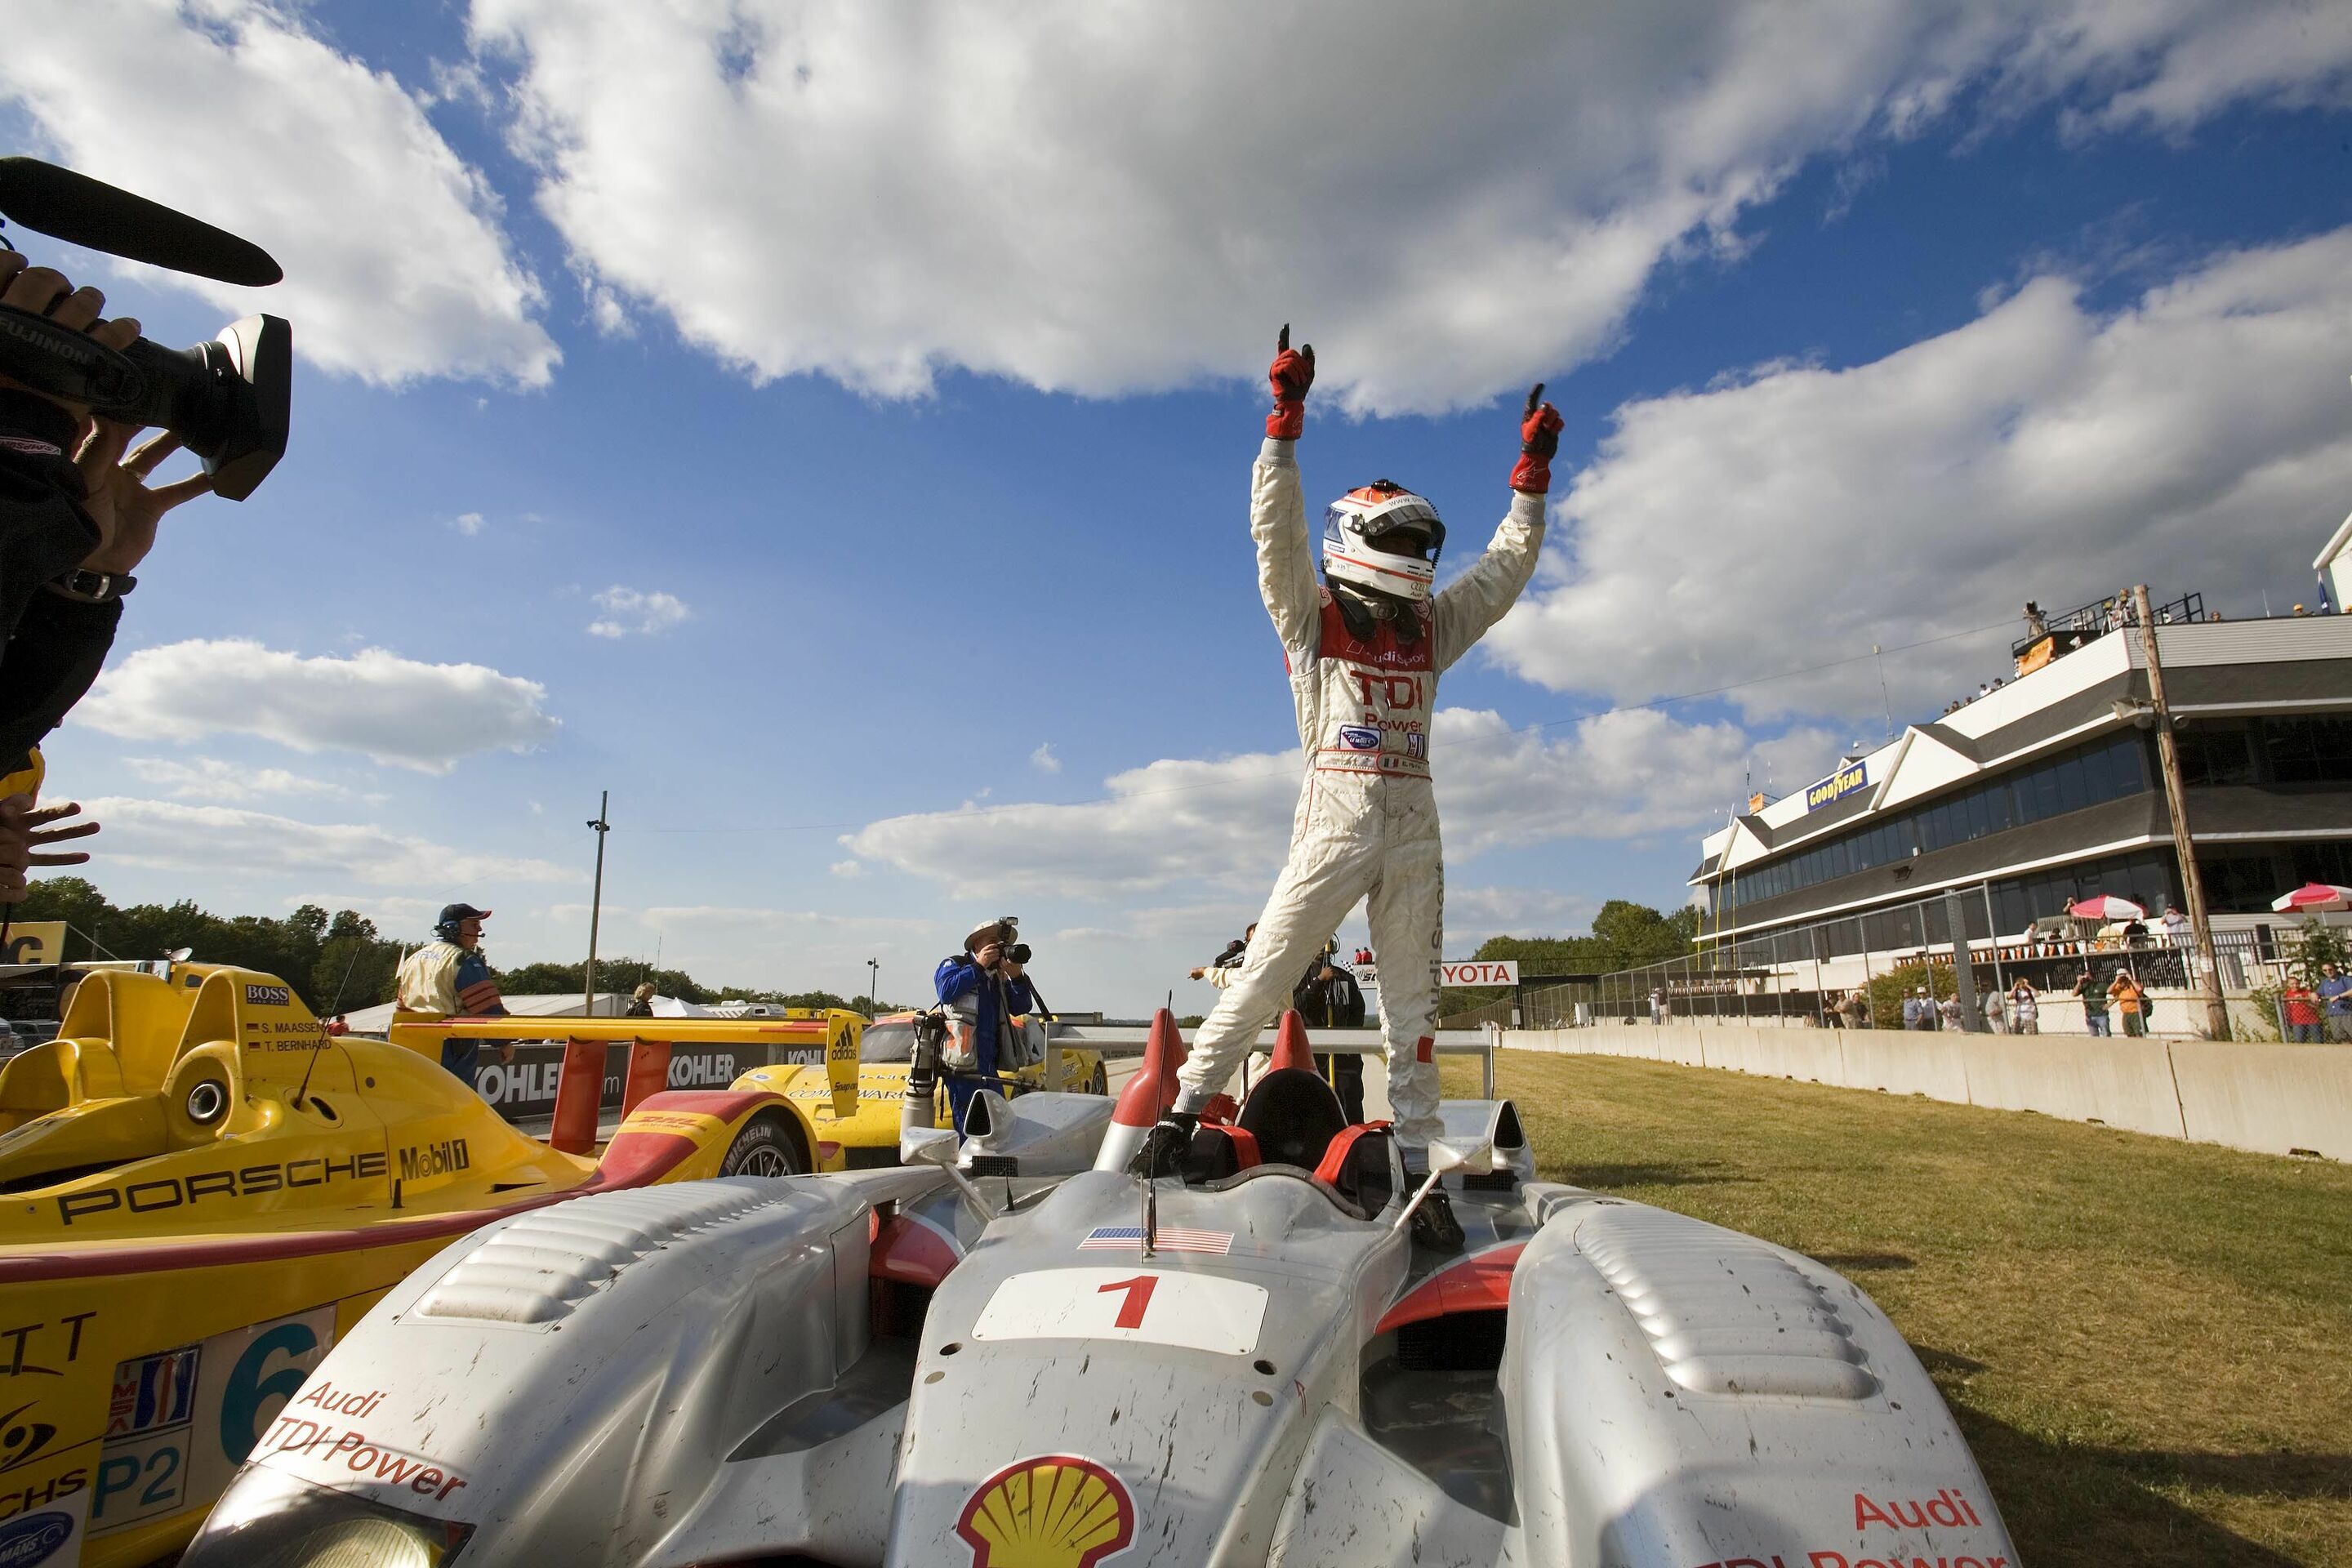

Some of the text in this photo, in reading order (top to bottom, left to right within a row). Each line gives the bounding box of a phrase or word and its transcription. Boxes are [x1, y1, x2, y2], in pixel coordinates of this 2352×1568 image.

[1350, 670, 1422, 711] TDI
[1365, 712, 1423, 733] Power
[1810, 768, 1863, 807] GOODYEAR
[1441, 964, 1510, 982] YOTA
[247, 986, 288, 1000] BOSS
[261, 1022, 325, 1033] S. MAASSEN
[265, 1040, 332, 1052] T. BERNHARD
[831, 1045, 858, 1060] adidas
[56, 1152, 386, 1225] PORSCHE
[1098, 1276, 1159, 1329] 1
[220, 1323, 318, 1468] 6
[297, 1381, 387, 1419] Audi
[264, 1417, 468, 1502] TDI Power
[91, 1446, 180, 1519] P2
[1854, 1489, 1982, 1530] Audi
